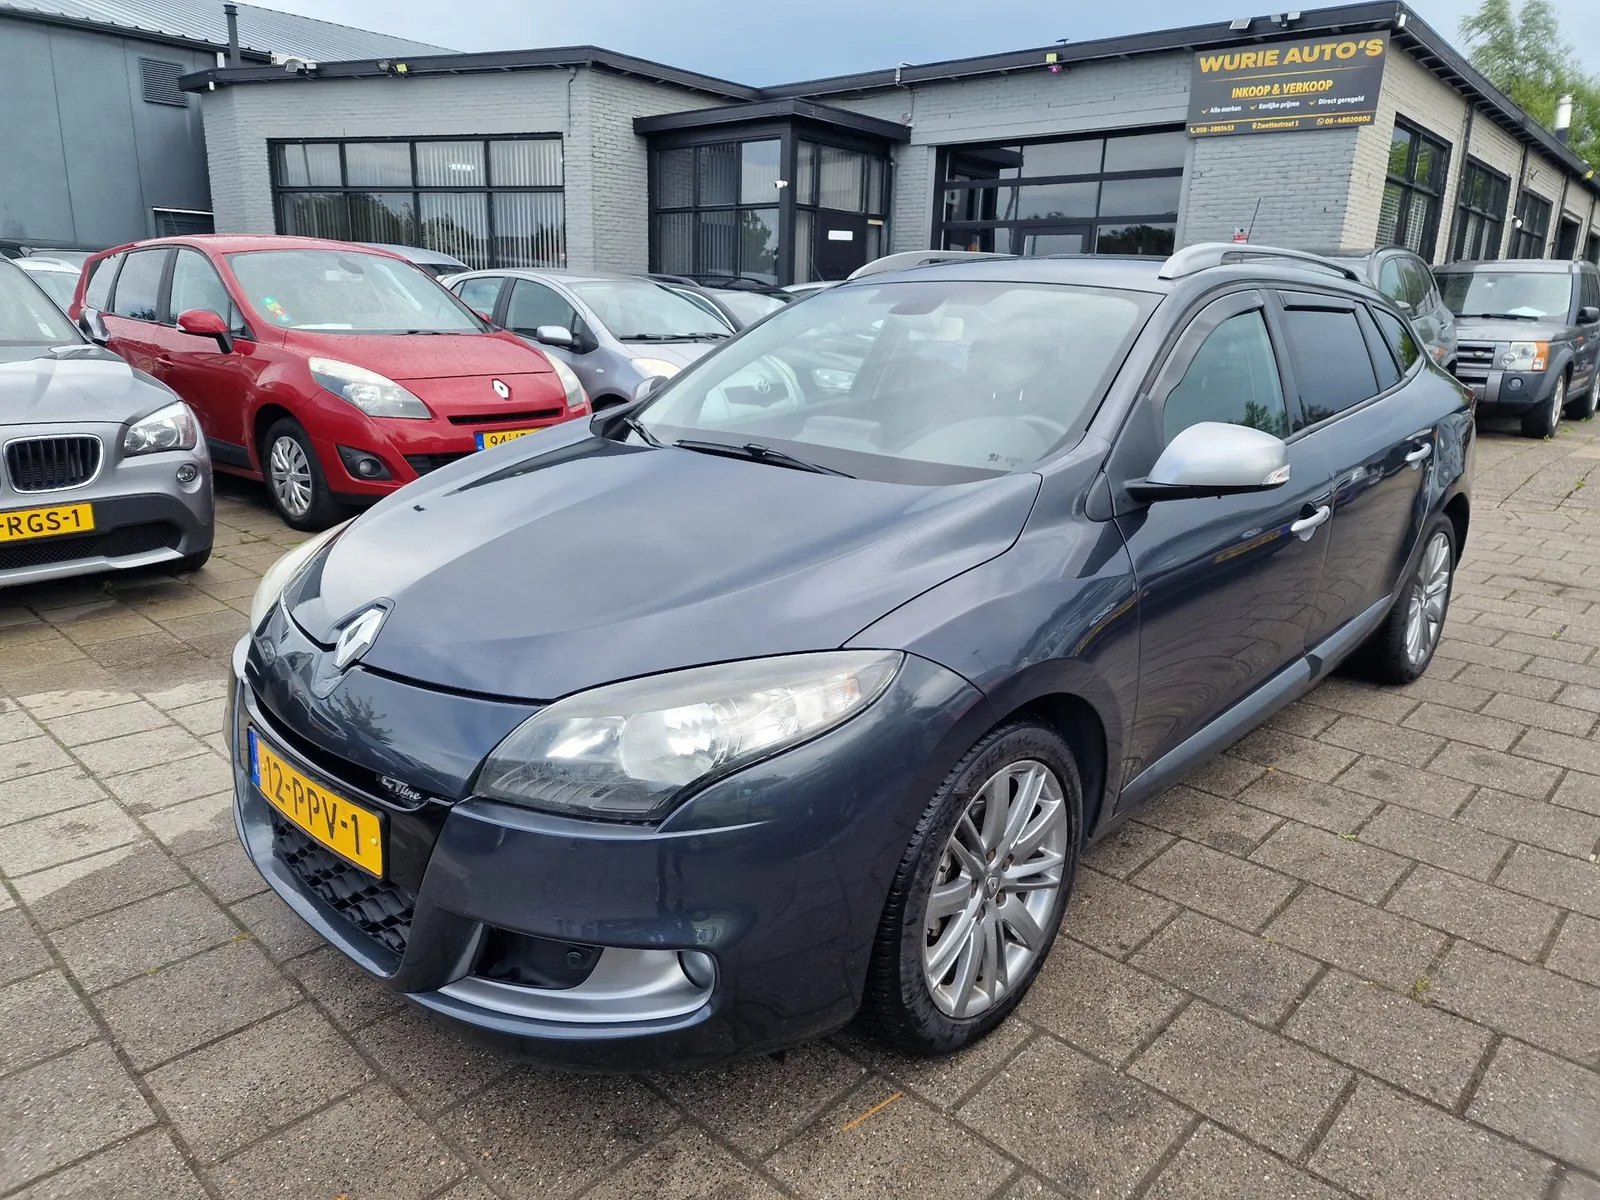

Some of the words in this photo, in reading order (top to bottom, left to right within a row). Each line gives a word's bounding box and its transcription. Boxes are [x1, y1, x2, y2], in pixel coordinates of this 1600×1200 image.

[1200, 50, 1279, 73] WURIE
[1282, 38, 1384, 65] AUTO'S
[1231, 84, 1271, 98] INKOOP
[1272, 83, 1281, 95] &
[1283, 79, 1334, 94] VERKOOP
[1258, 101, 1280, 110] Eerlijke
[1280, 100, 1300, 110] prijzen
[1318, 97, 1337, 106] Direct
[1337, 94, 1365, 105] geregeld
[1209, 106, 1220, 114] Alle
[1221, 105, 1242, 113] merken
[265, 755, 361, 855] 12-PPV-1
